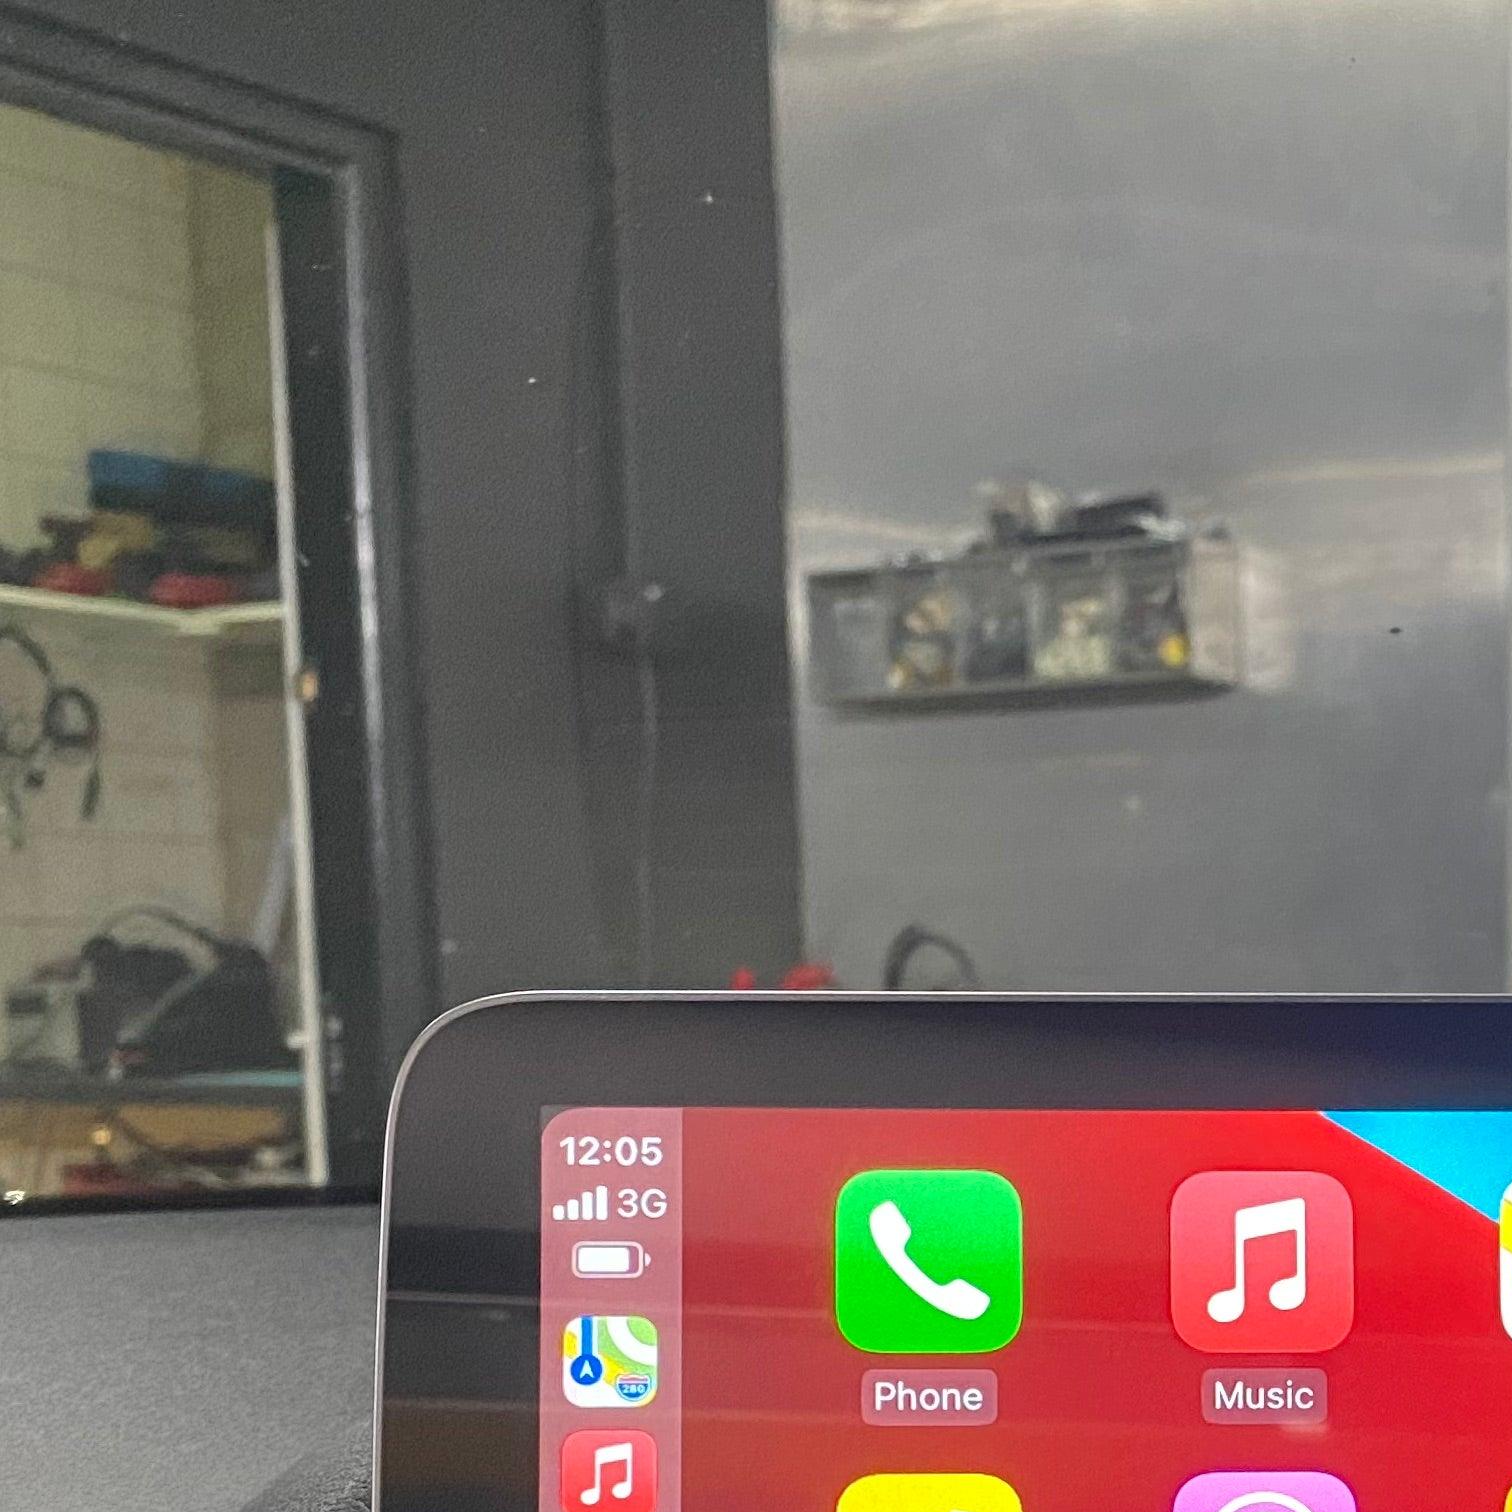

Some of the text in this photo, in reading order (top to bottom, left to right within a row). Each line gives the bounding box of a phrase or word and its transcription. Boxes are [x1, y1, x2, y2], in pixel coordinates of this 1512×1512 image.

[560, 1137, 662, 1165] 12:05
[618, 1189, 667, 1218] 3G
[876, 1381, 982, 1410] Phone
[1216, 1380, 1313, 1409] Music
